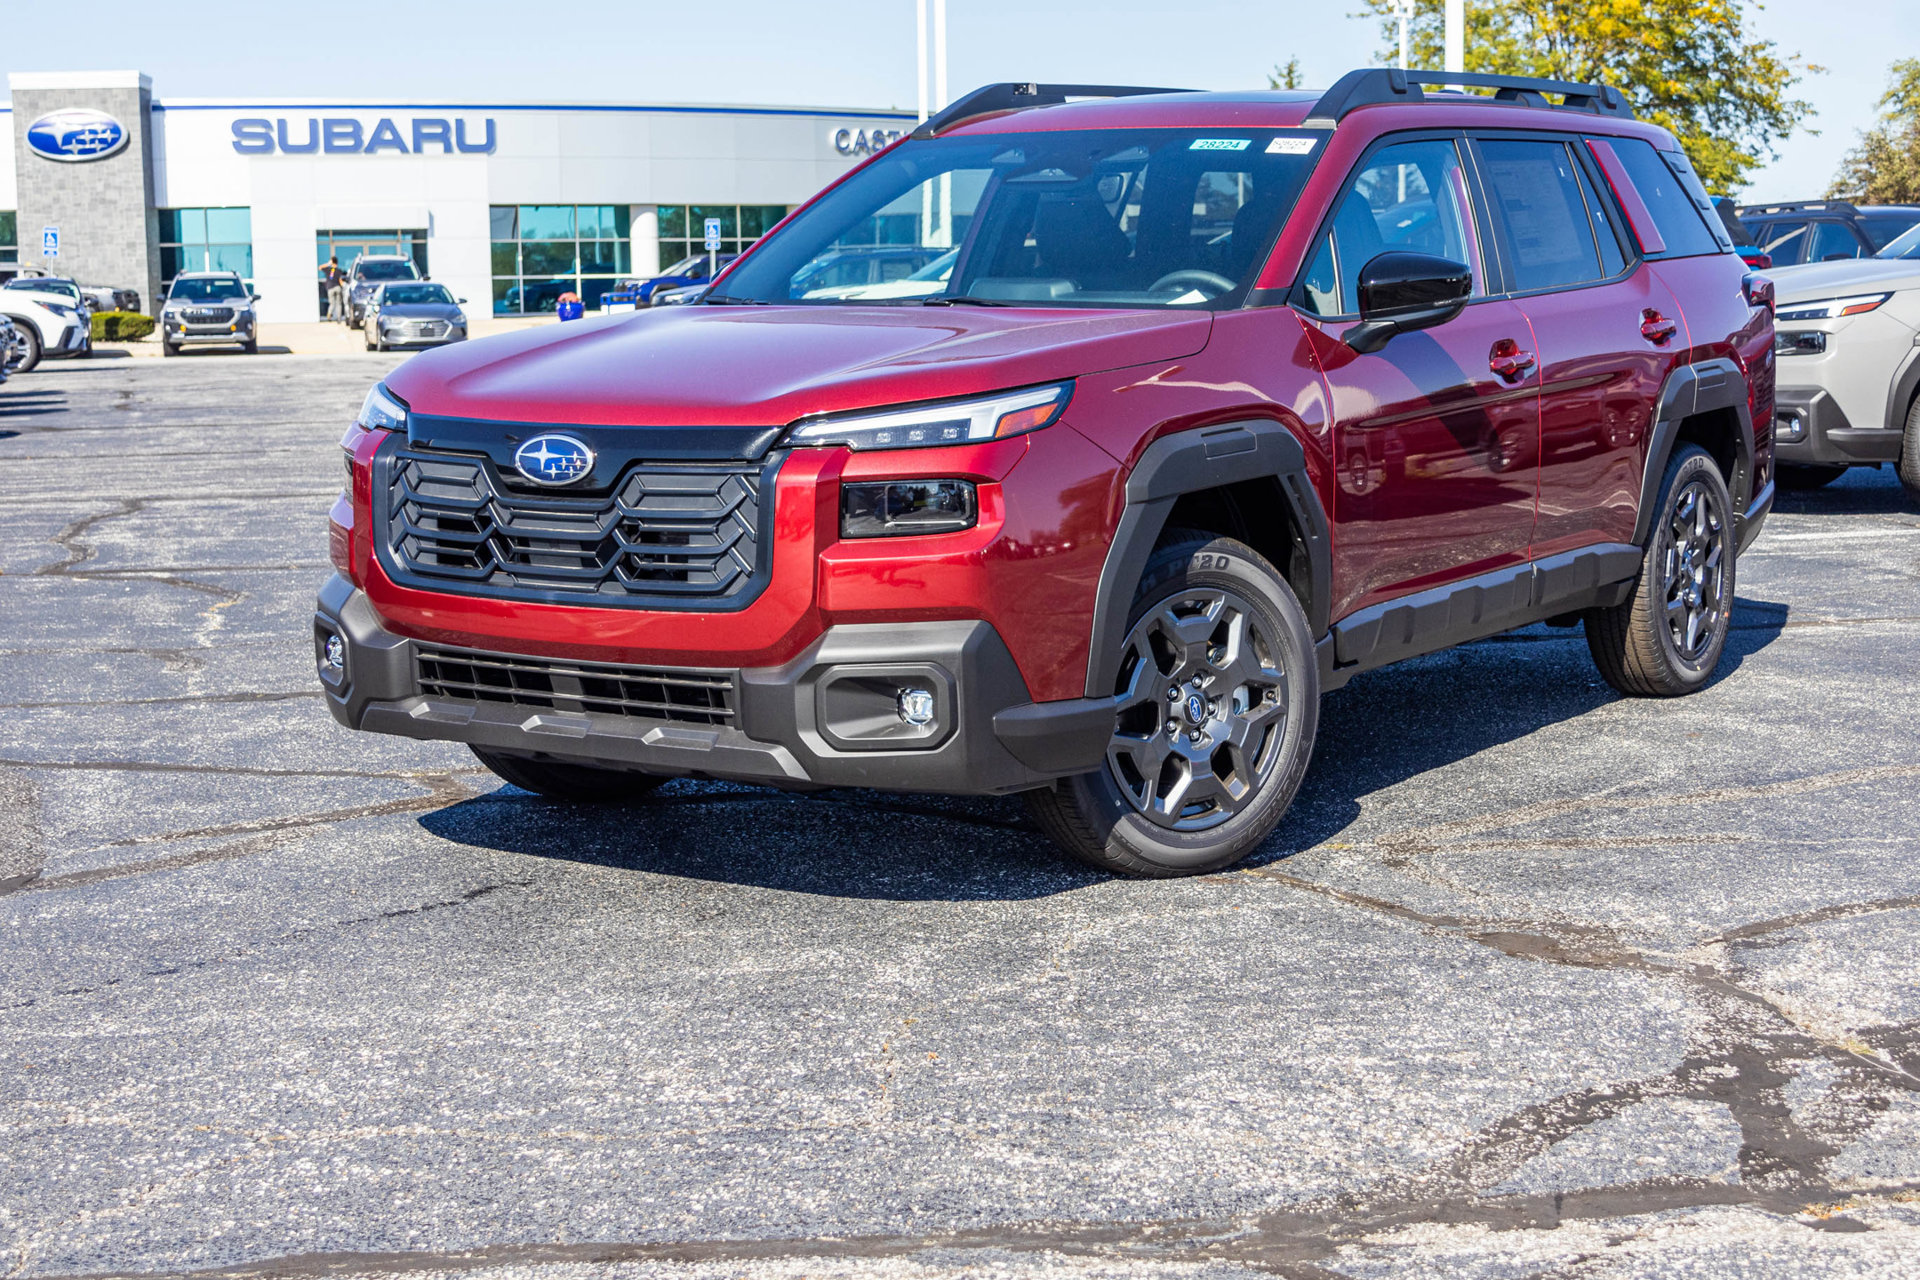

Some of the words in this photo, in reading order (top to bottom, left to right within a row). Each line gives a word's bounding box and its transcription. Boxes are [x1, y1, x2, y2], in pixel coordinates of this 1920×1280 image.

[231, 118, 497, 156] SUBARU
[835, 128, 907, 153] CAST
[1198, 140, 1240, 149] 28224
